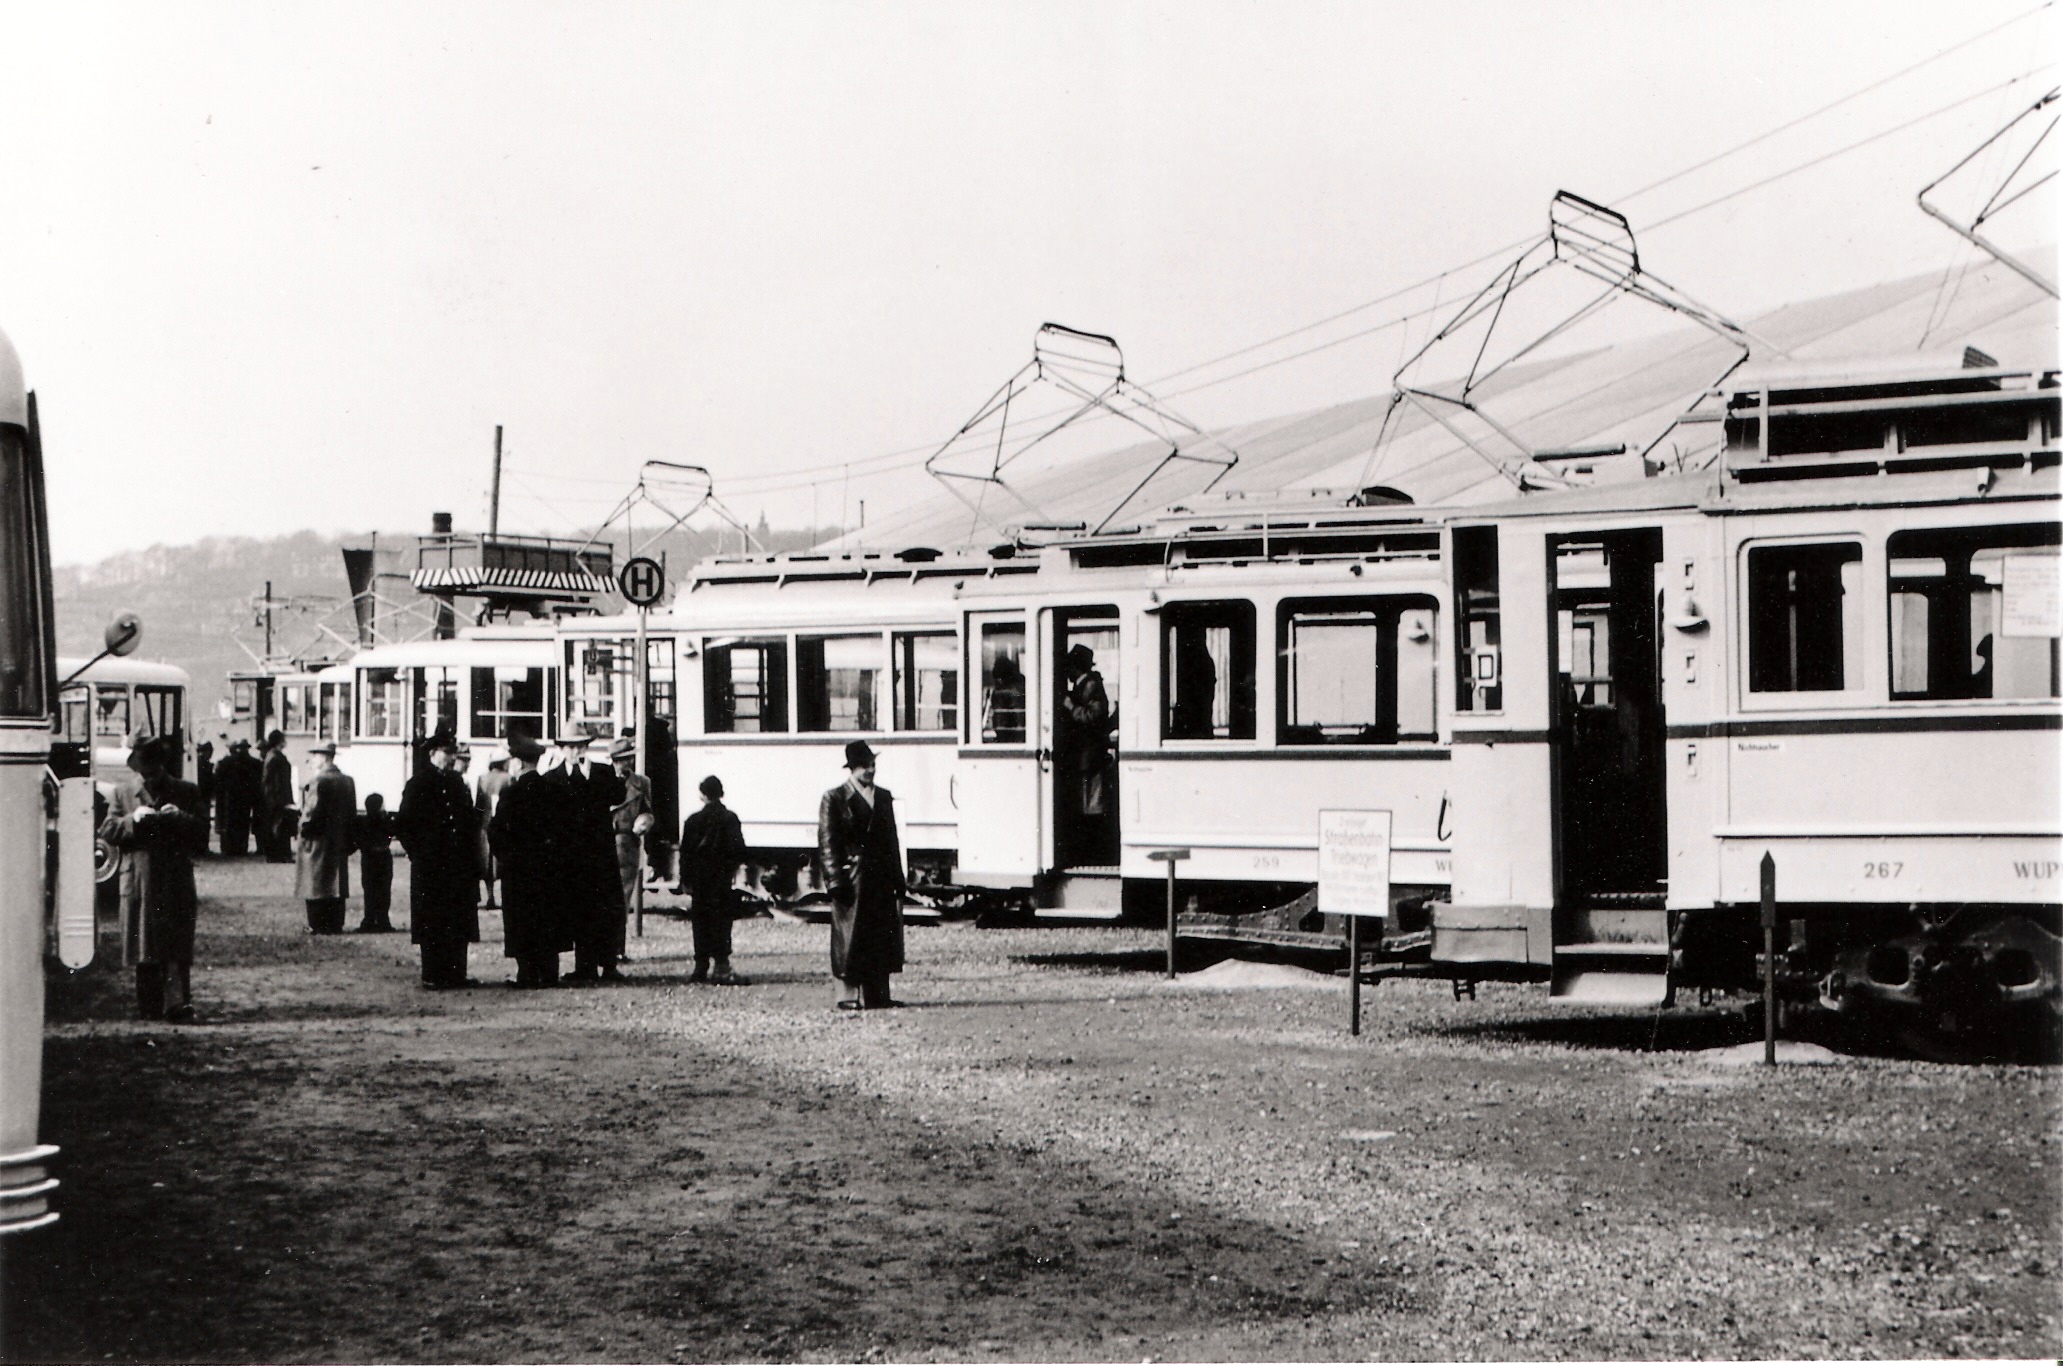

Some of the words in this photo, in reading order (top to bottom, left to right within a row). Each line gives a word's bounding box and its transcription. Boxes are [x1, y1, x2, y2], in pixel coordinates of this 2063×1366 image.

[631, 566, 653, 597] H
[1253, 855, 1280, 869] 259
[1863, 862, 1905, 879] 267
